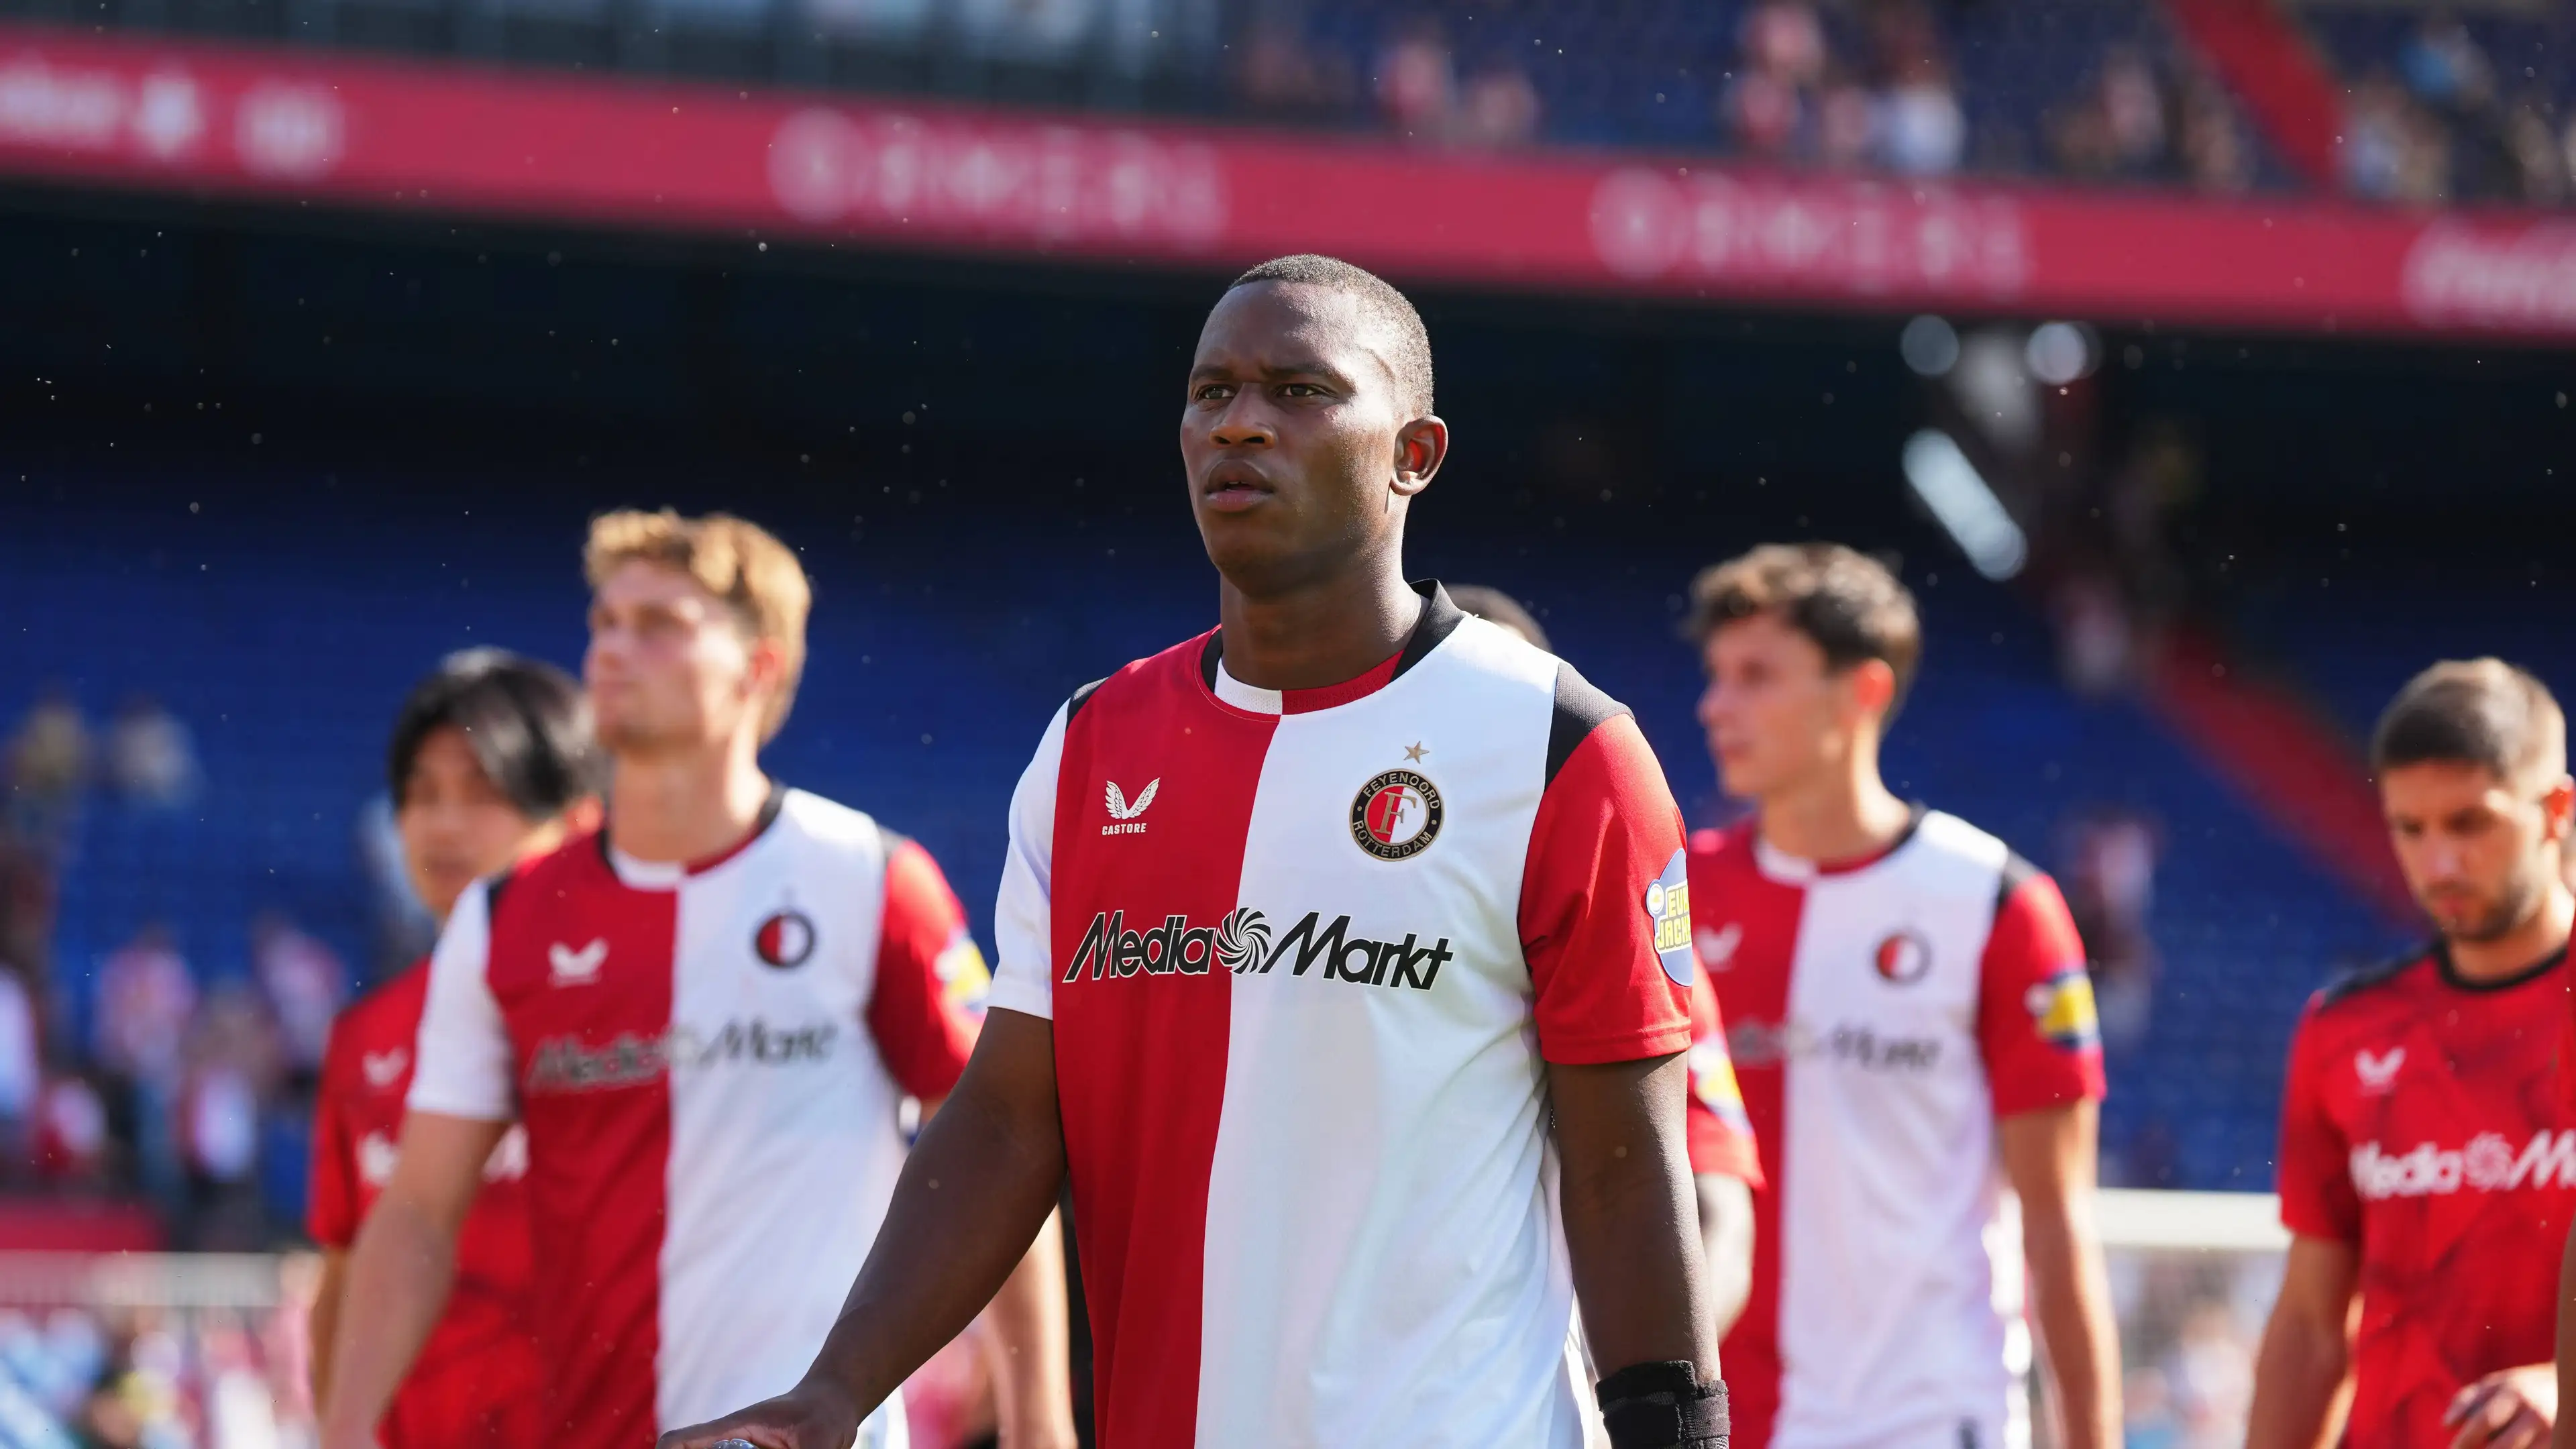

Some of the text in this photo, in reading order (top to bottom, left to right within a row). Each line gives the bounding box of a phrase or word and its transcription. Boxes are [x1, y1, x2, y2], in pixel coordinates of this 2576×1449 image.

[1362, 772, 1440, 810] FEYENOORD
[1102, 822, 1147, 836] CASTORE
[1352, 820, 1434, 857] ROTTERDAM
[1062, 909, 1454, 991] Media Markt
